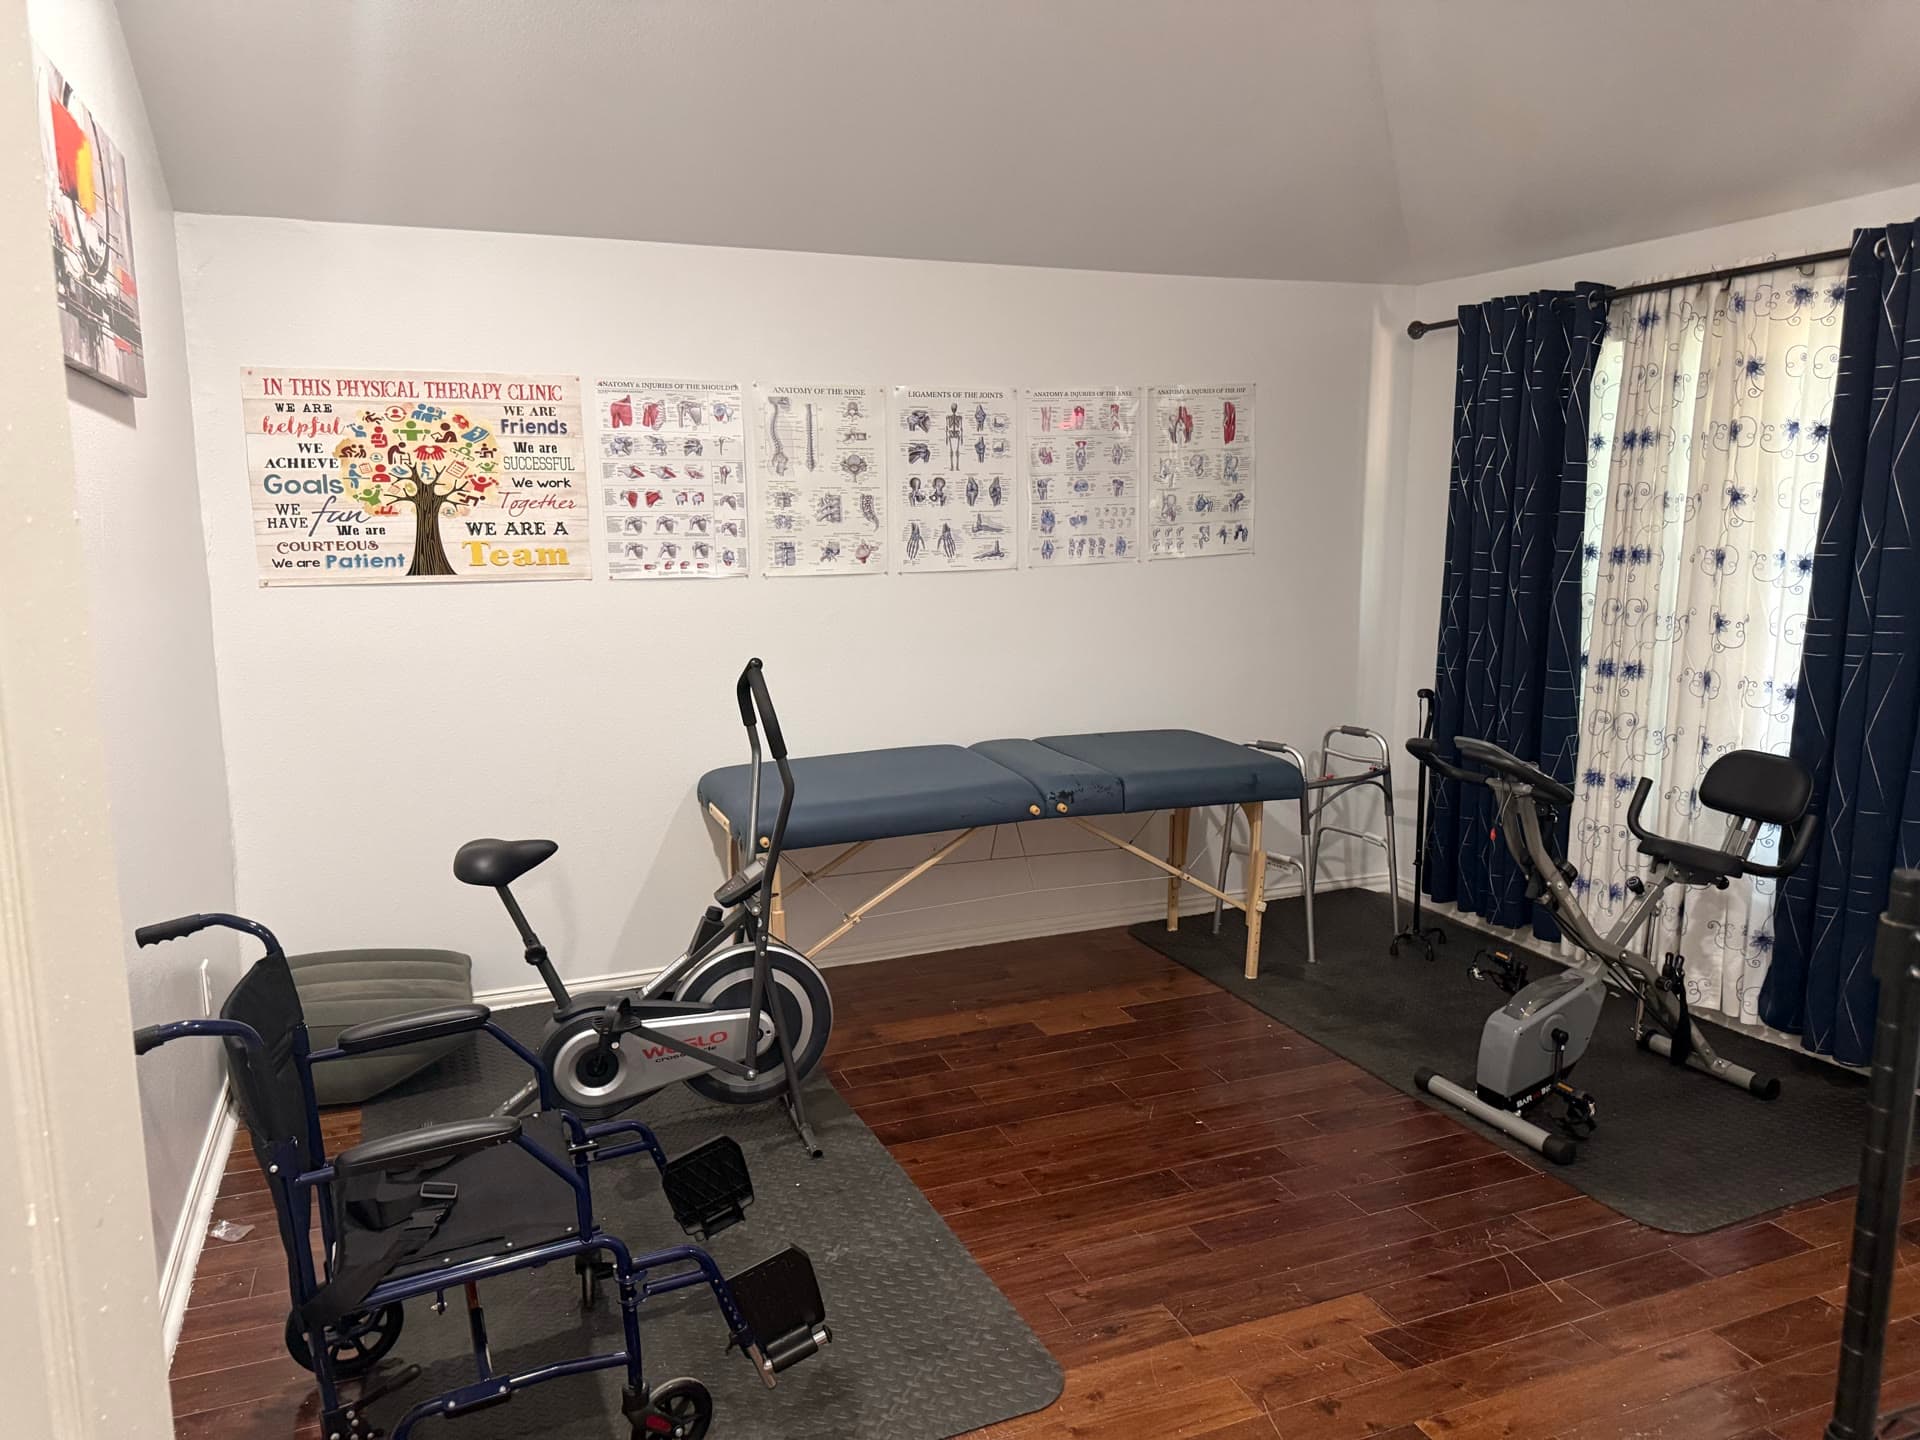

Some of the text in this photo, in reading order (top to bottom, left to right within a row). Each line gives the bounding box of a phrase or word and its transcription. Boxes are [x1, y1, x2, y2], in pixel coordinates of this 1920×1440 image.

[262, 378, 563, 402] IN THIS PHYSICAL THERAPY CLINIC
[597, 380, 634, 389] ANATOMY
[641, 382, 673, 390] INJURIES
[685, 383, 700, 391] THE
[773, 386, 813, 395] ANATOMY
[827, 388, 842, 396] THE
[843, 388, 867, 396] SPINE
[908, 391, 1004, 399] LIGAMENTS OF THE JOINTS
[275, 402, 333, 414] WE ARE
[503, 405, 557, 417] WE ARE
[262, 415, 345, 439] helpful
[500, 418, 568, 435] Friends
[297, 442, 324, 454] WE
[513, 441, 558, 454] We are
[264, 457, 339, 470] ACHIEVE
[503, 456, 576, 471] SUCCESSFUL
[263, 473, 344, 495] Goals
[511, 477, 572, 488] We work
[275, 503, 301, 516] WE
[497, 491, 578, 518] Together
[266, 494, 372, 538] HAVE fun
[335, 525, 386, 536] We are
[465, 521, 569, 536] WE ARE A
[276, 540, 379, 555] COURTEOUS
[461, 540, 570, 567] Team
[271, 553, 406, 569] We are Patient
